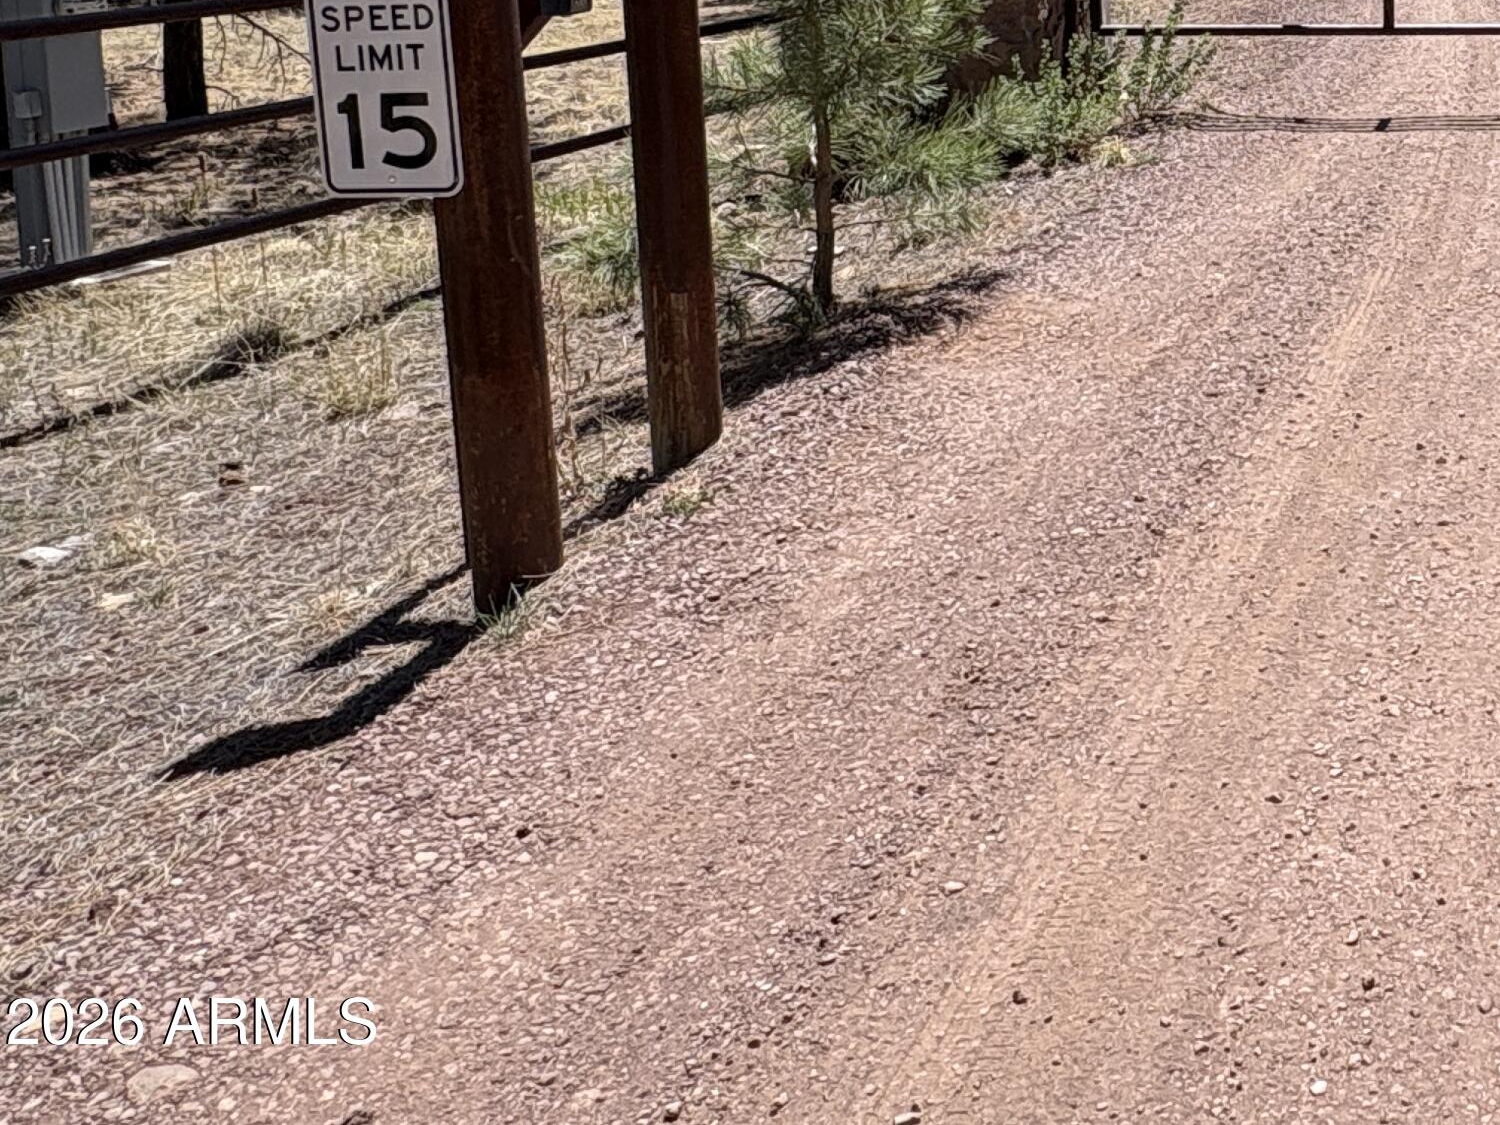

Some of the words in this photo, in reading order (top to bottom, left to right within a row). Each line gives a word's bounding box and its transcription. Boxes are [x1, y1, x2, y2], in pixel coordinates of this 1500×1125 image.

[321, 4, 433, 32] SPEED
[335, 43, 424, 72] LIMIT
[337, 92, 437, 170] 15
